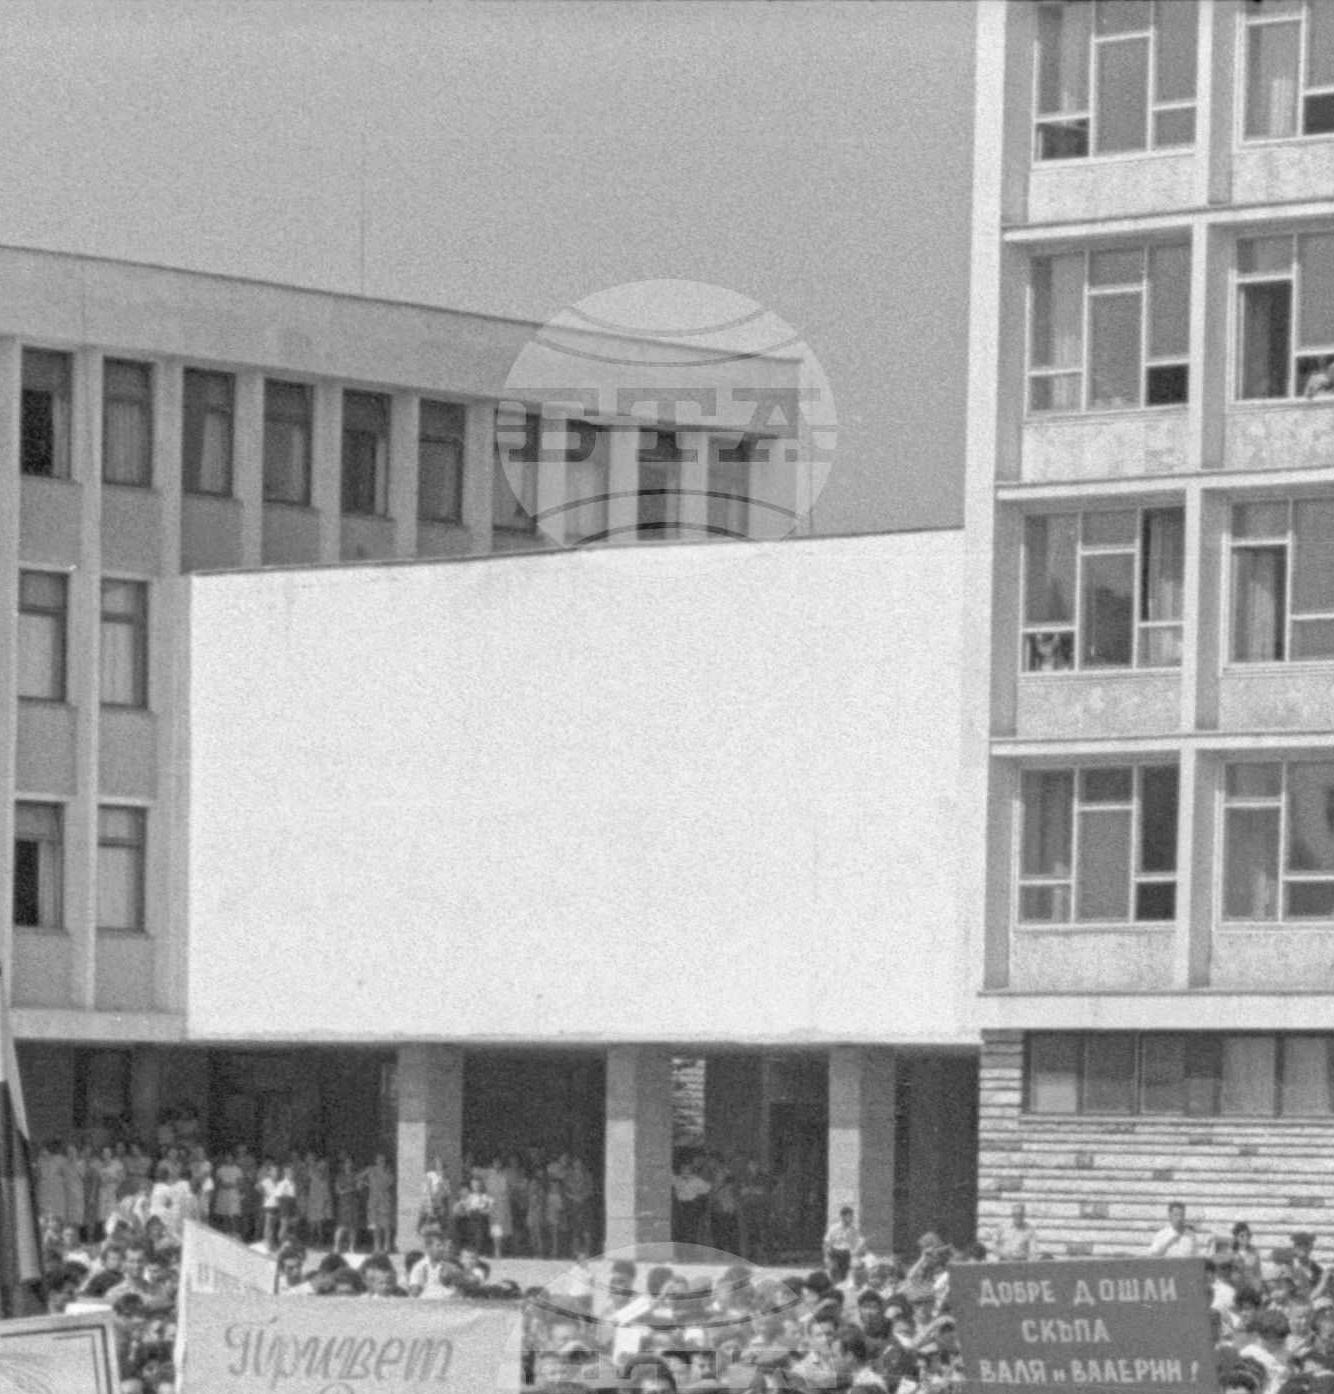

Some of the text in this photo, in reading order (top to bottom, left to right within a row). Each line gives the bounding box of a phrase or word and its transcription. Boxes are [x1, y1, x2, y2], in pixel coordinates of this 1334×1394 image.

[980, 1277, 1178, 1307] ДОБРЕ ДОШЛИ
[1021, 1318, 1111, 1343] СКЪПА
[224, 1316, 454, 1389] Привет
[979, 1359, 1046, 1384] ВАЛЯ
